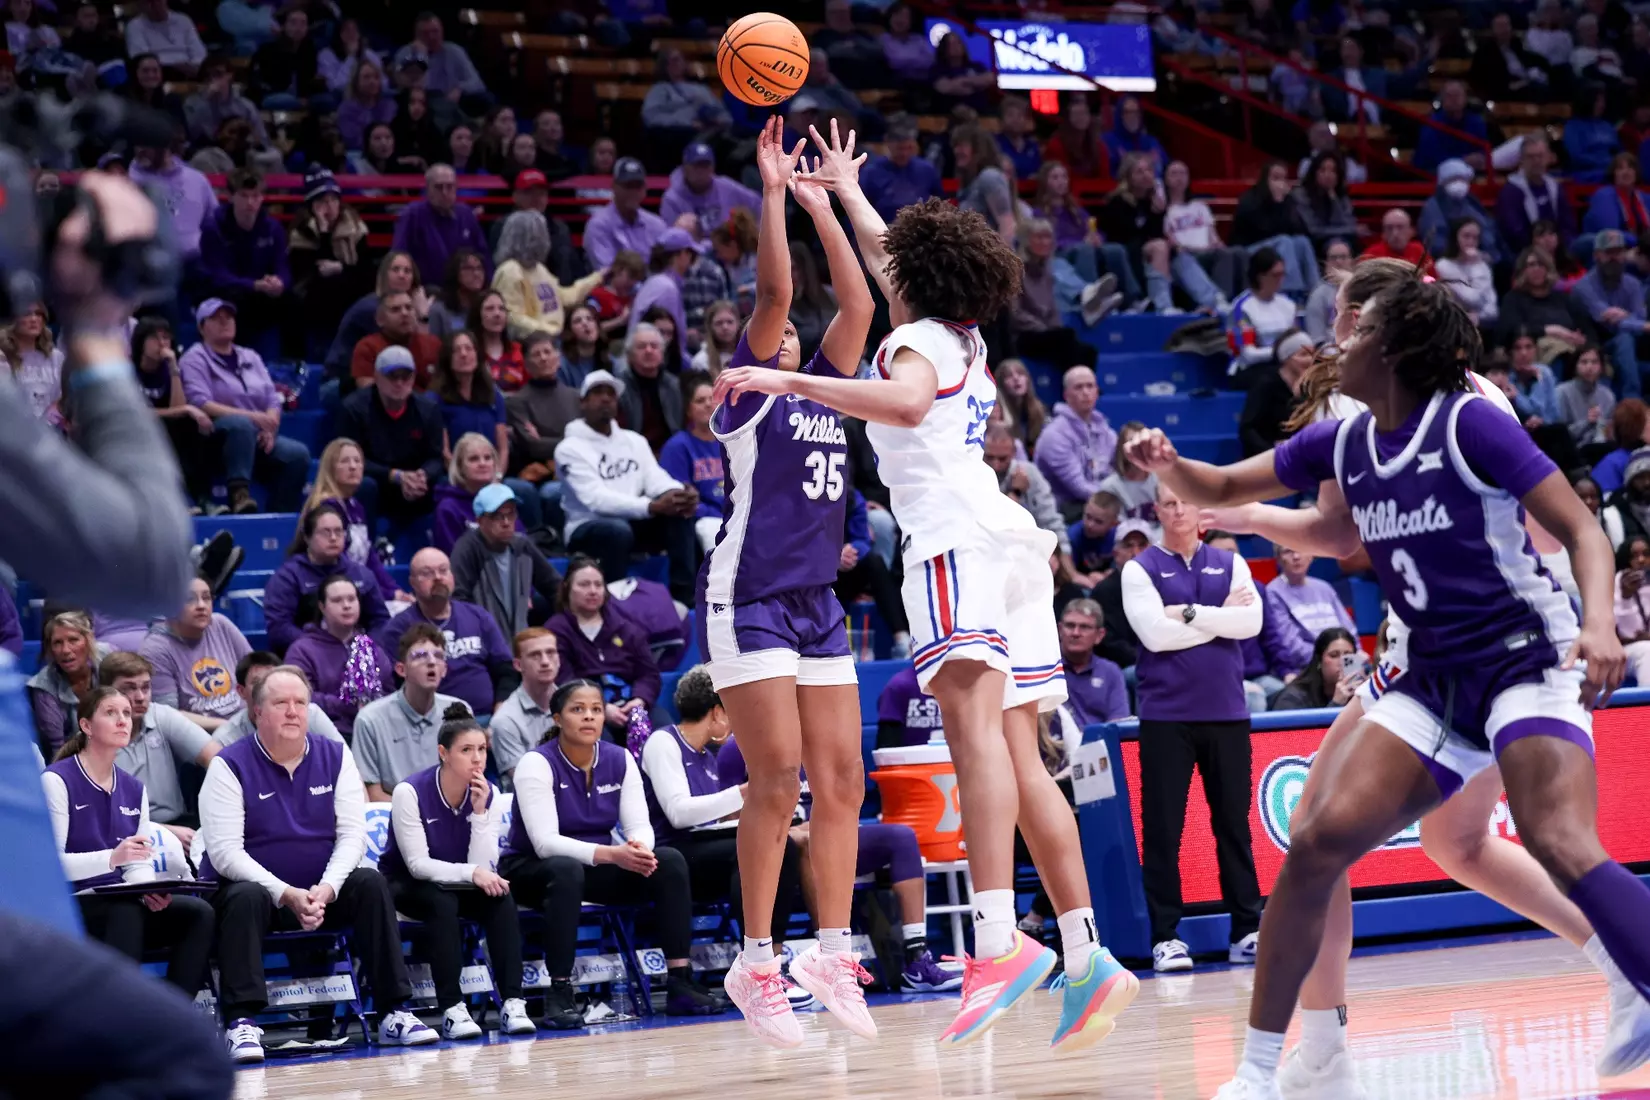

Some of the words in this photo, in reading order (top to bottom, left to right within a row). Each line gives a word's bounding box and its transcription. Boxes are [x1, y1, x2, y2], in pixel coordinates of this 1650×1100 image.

[772, 60, 803, 80] EVO
[746, 75, 794, 103] ilson
[802, 450, 847, 502] 35
[1351, 493, 1455, 542] Wildcats
[1390, 548, 1429, 611] 3
[908, 698, 942, 717] K-S
[308, 983, 348, 995] Federal
[460, 974, 485, 986] deral
